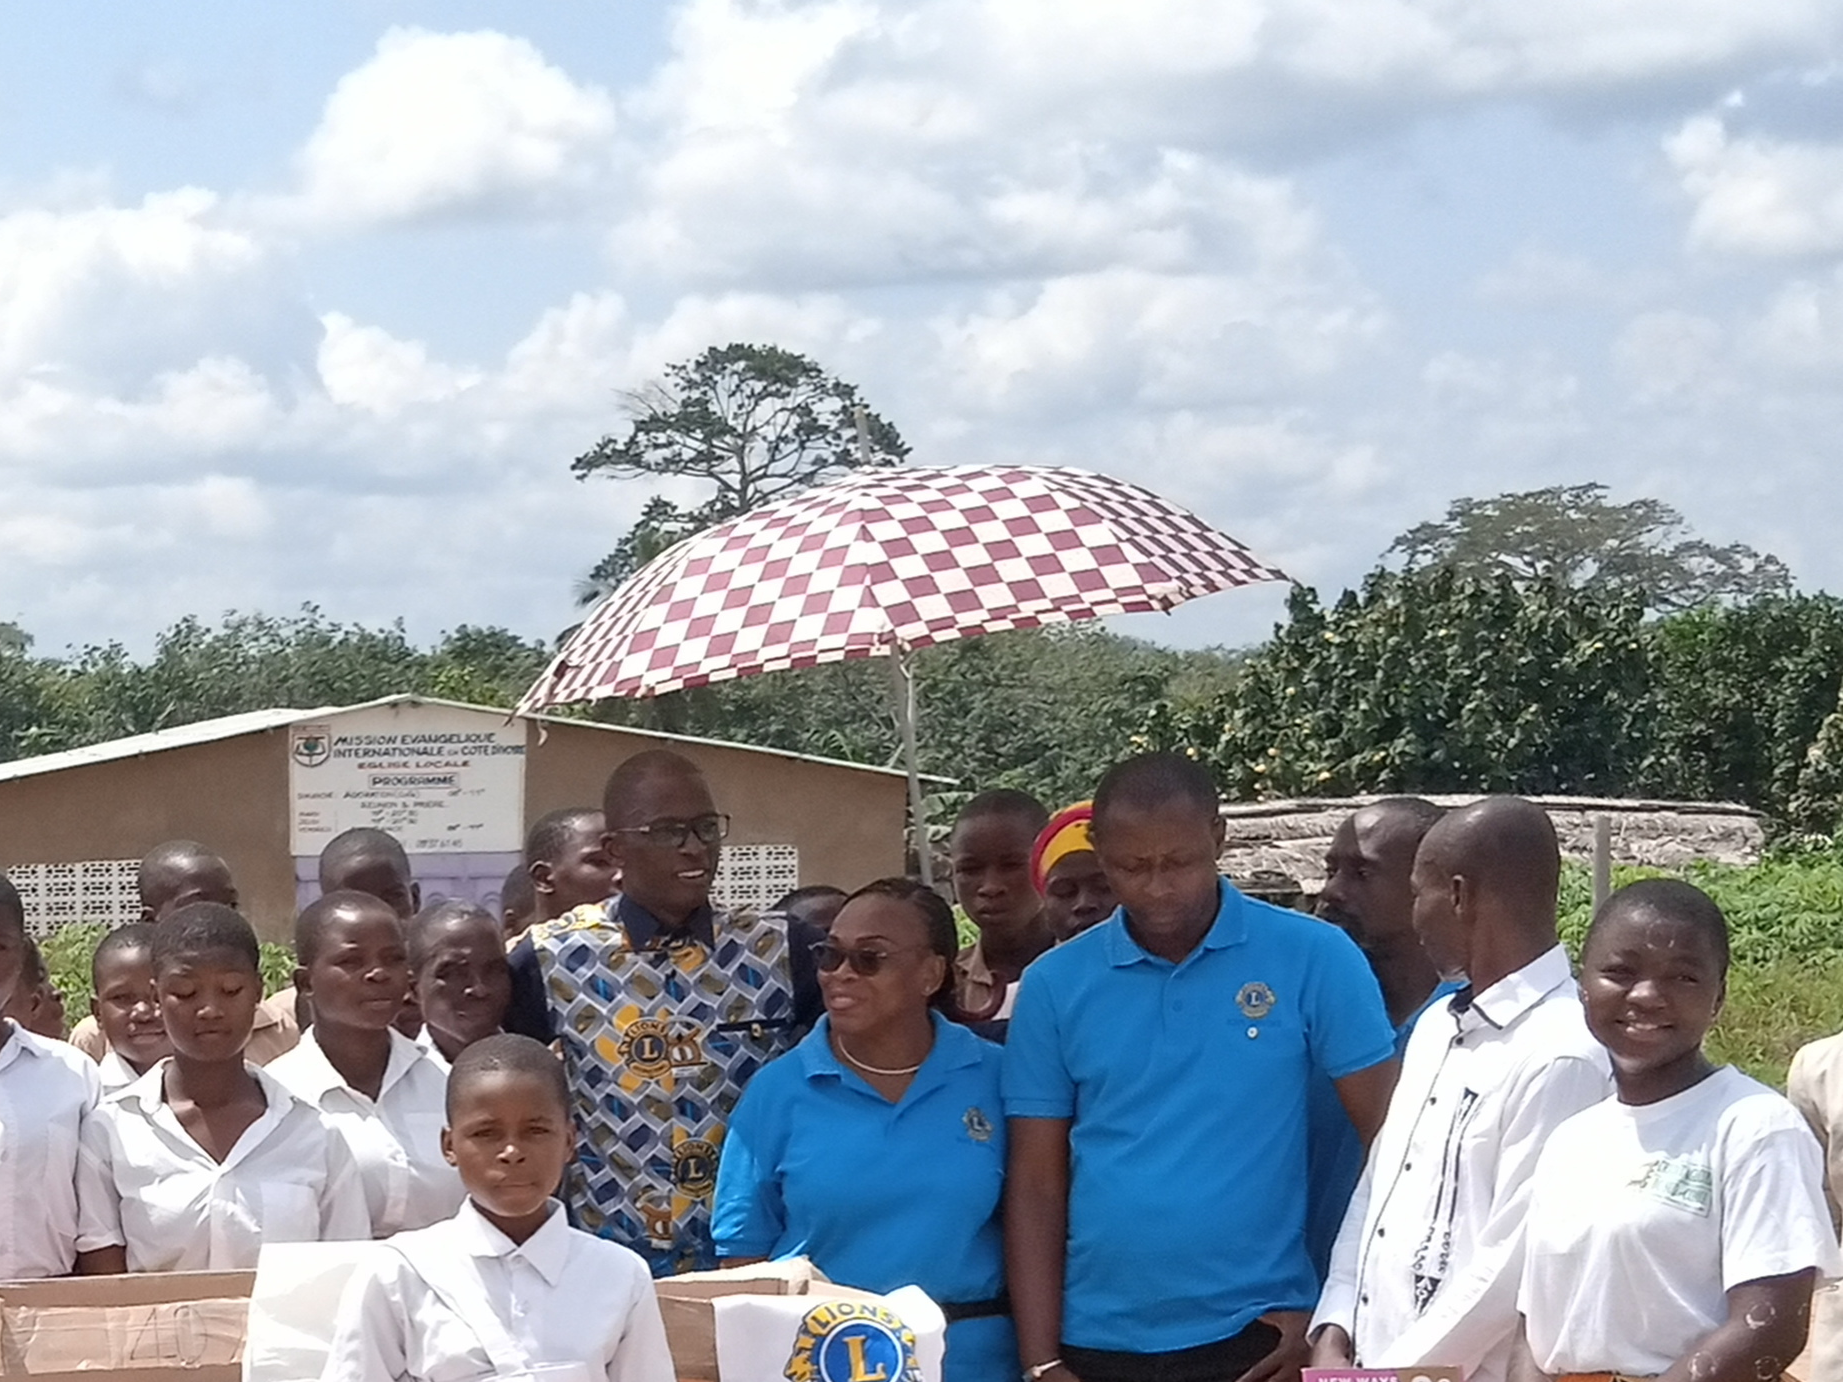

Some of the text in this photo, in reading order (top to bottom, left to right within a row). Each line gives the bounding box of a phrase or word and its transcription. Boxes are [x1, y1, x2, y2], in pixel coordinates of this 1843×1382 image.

[334, 733, 496, 746] MISSION EVANGELIQUE
[333, 746, 444, 758] INTERNATIONALE
[357, 760, 471, 769] EGLISE LOCALE
[372, 775, 456, 788] PROGRAMME
[810, 1301, 895, 1331] LIONS
